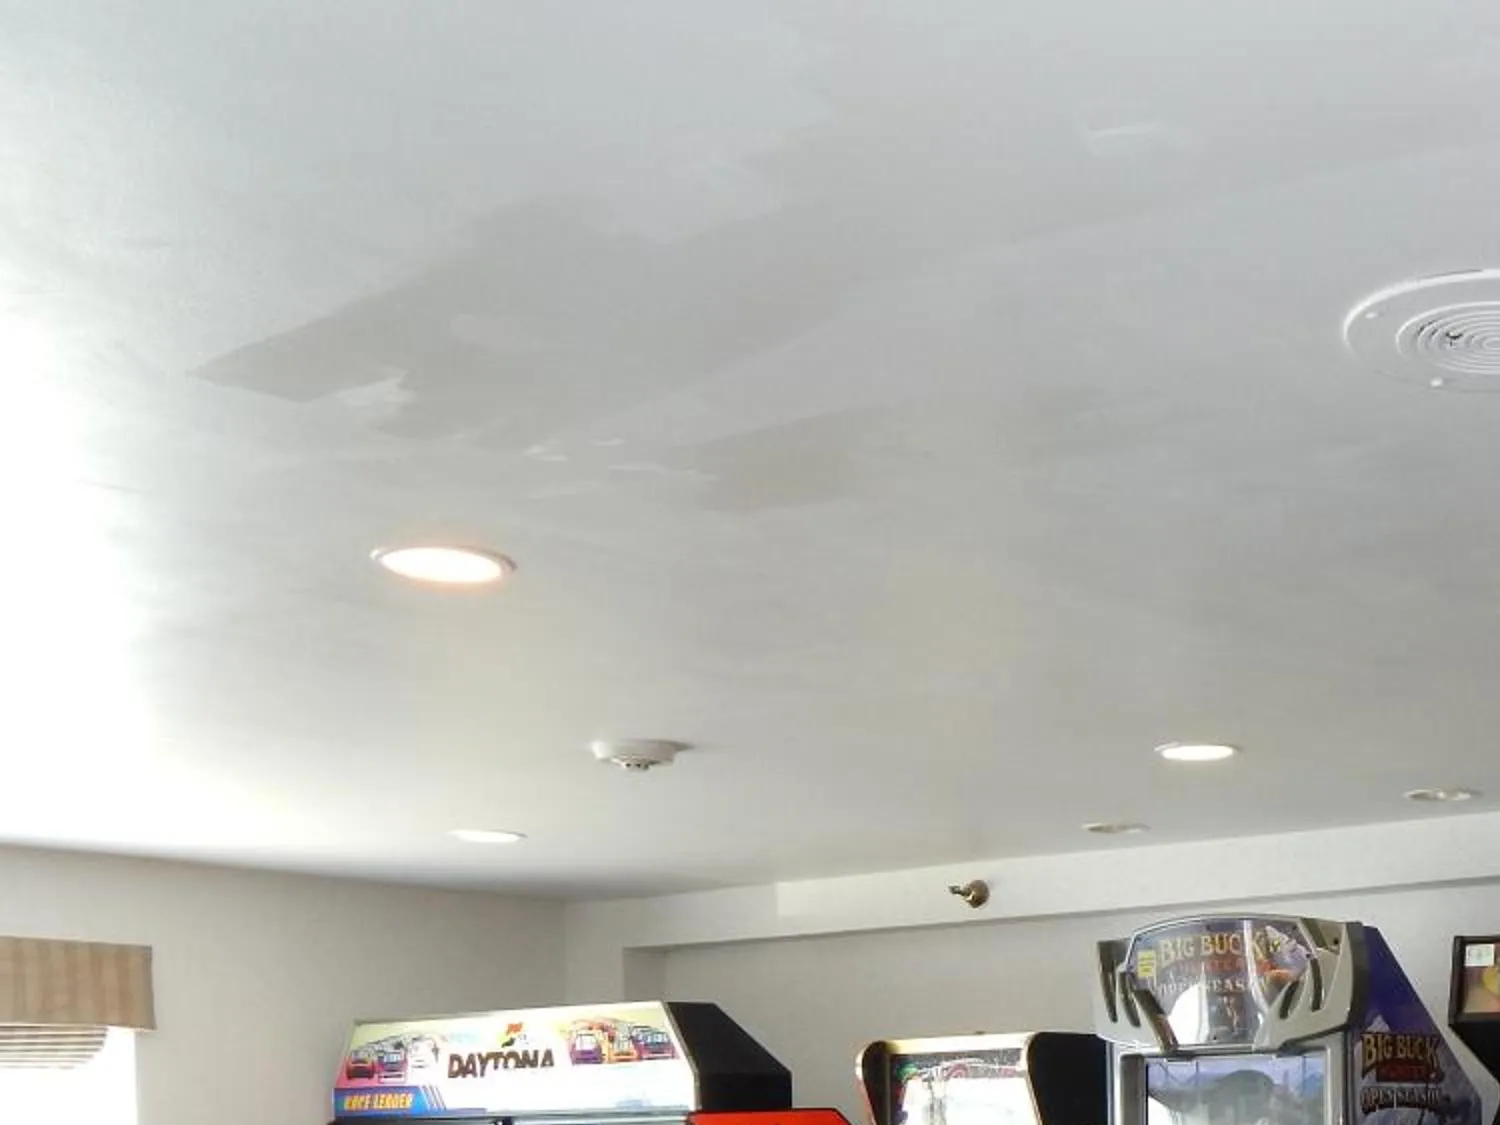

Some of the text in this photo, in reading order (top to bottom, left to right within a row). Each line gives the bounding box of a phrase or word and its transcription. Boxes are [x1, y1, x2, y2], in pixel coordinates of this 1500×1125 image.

[1159, 936, 1195, 966] BIG
[447, 1048, 555, 1079] DAYTONA
[1361, 1033, 1394, 1069] BIG
